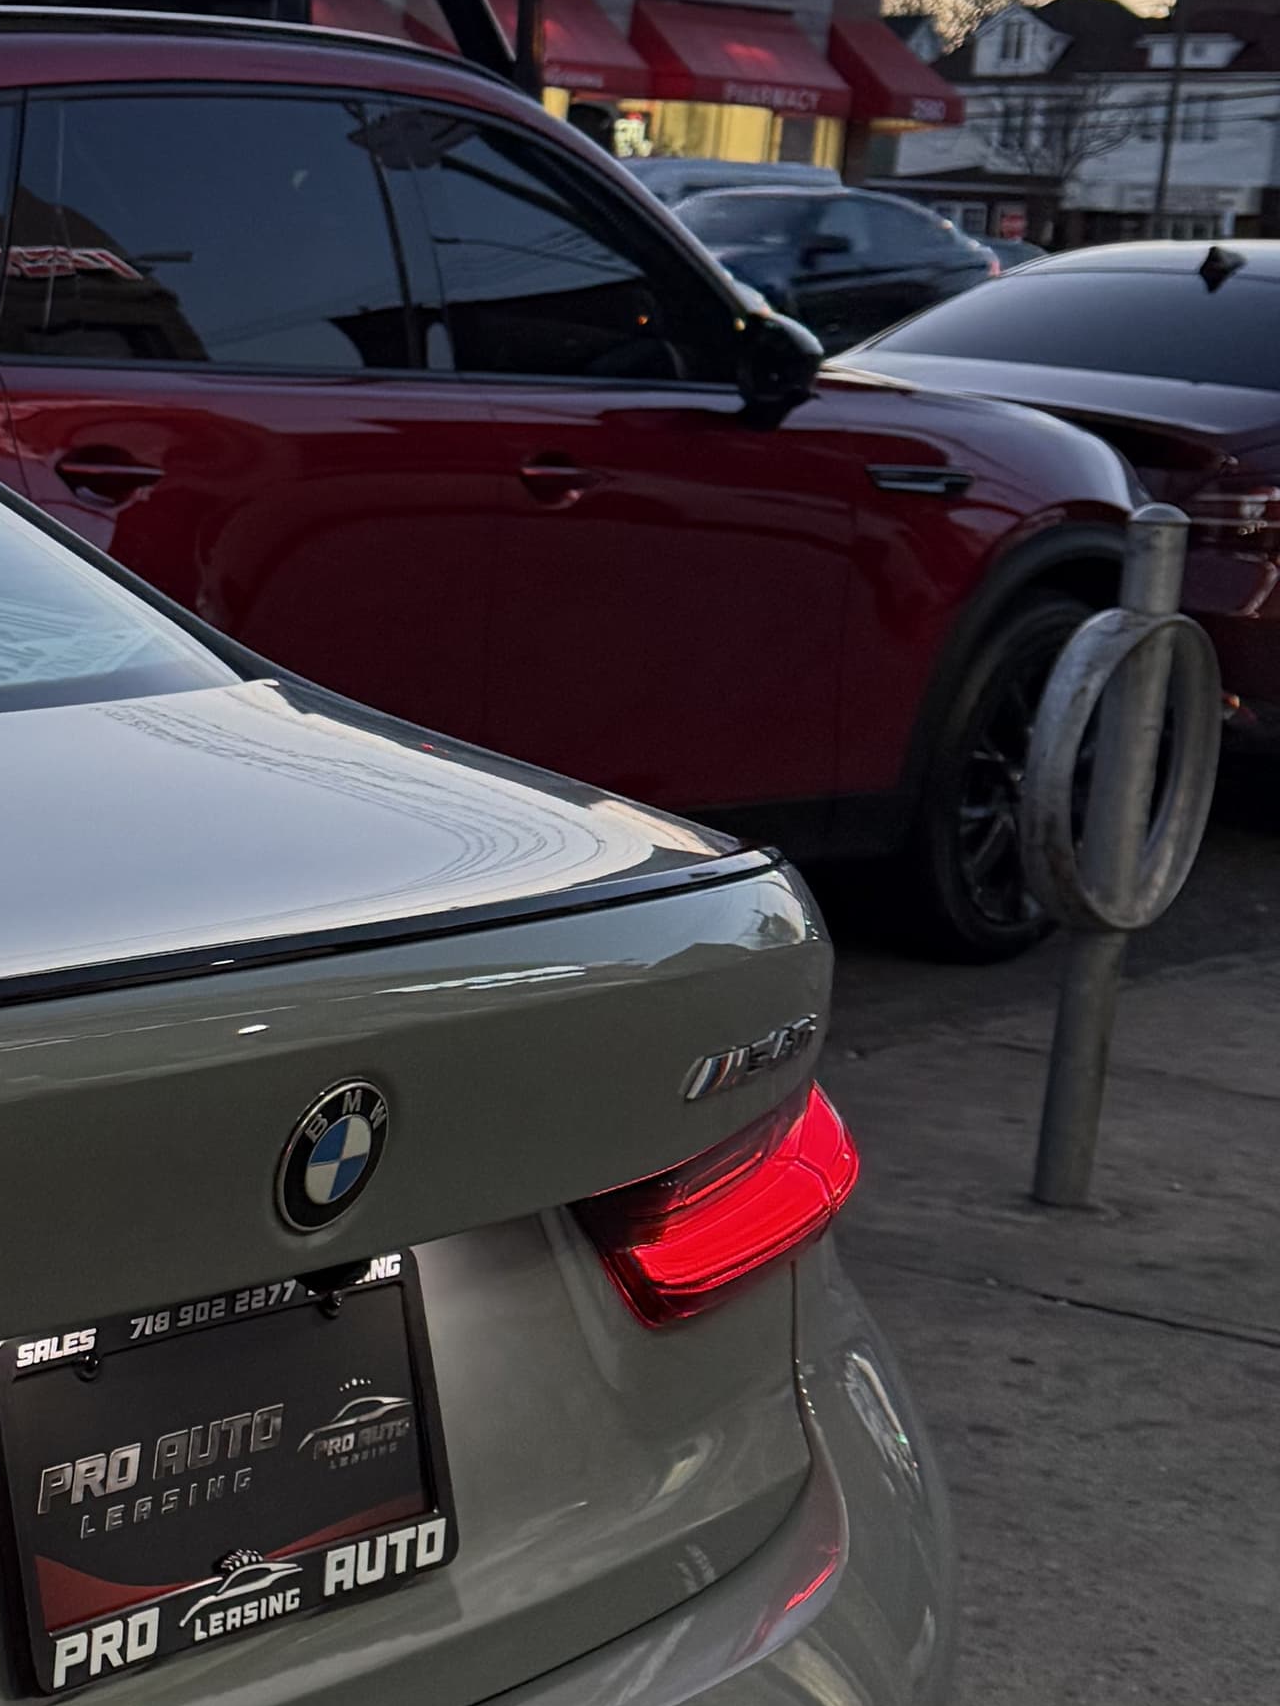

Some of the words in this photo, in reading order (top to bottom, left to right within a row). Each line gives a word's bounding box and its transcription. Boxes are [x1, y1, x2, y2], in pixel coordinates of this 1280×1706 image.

[305, 1089, 387, 1143] BMW
[16, 1327, 96, 1368] SALES
[129, 1310, 170, 1341] 718
[177, 1296, 227, 1328] 902
[234, 1279, 297, 1315] 2277
[38, 1442, 142, 1515] PRO
[153, 1403, 286, 1482] AUTO
[313, 1433, 355, 1461] PRO
[358, 1417, 411, 1448] AUTO
[80, 1466, 254, 1541] LEASING
[52, 1607, 160, 1689] PRO
[194, 1588, 301, 1642] LEASING
[323, 1517, 447, 1597] AUTO
